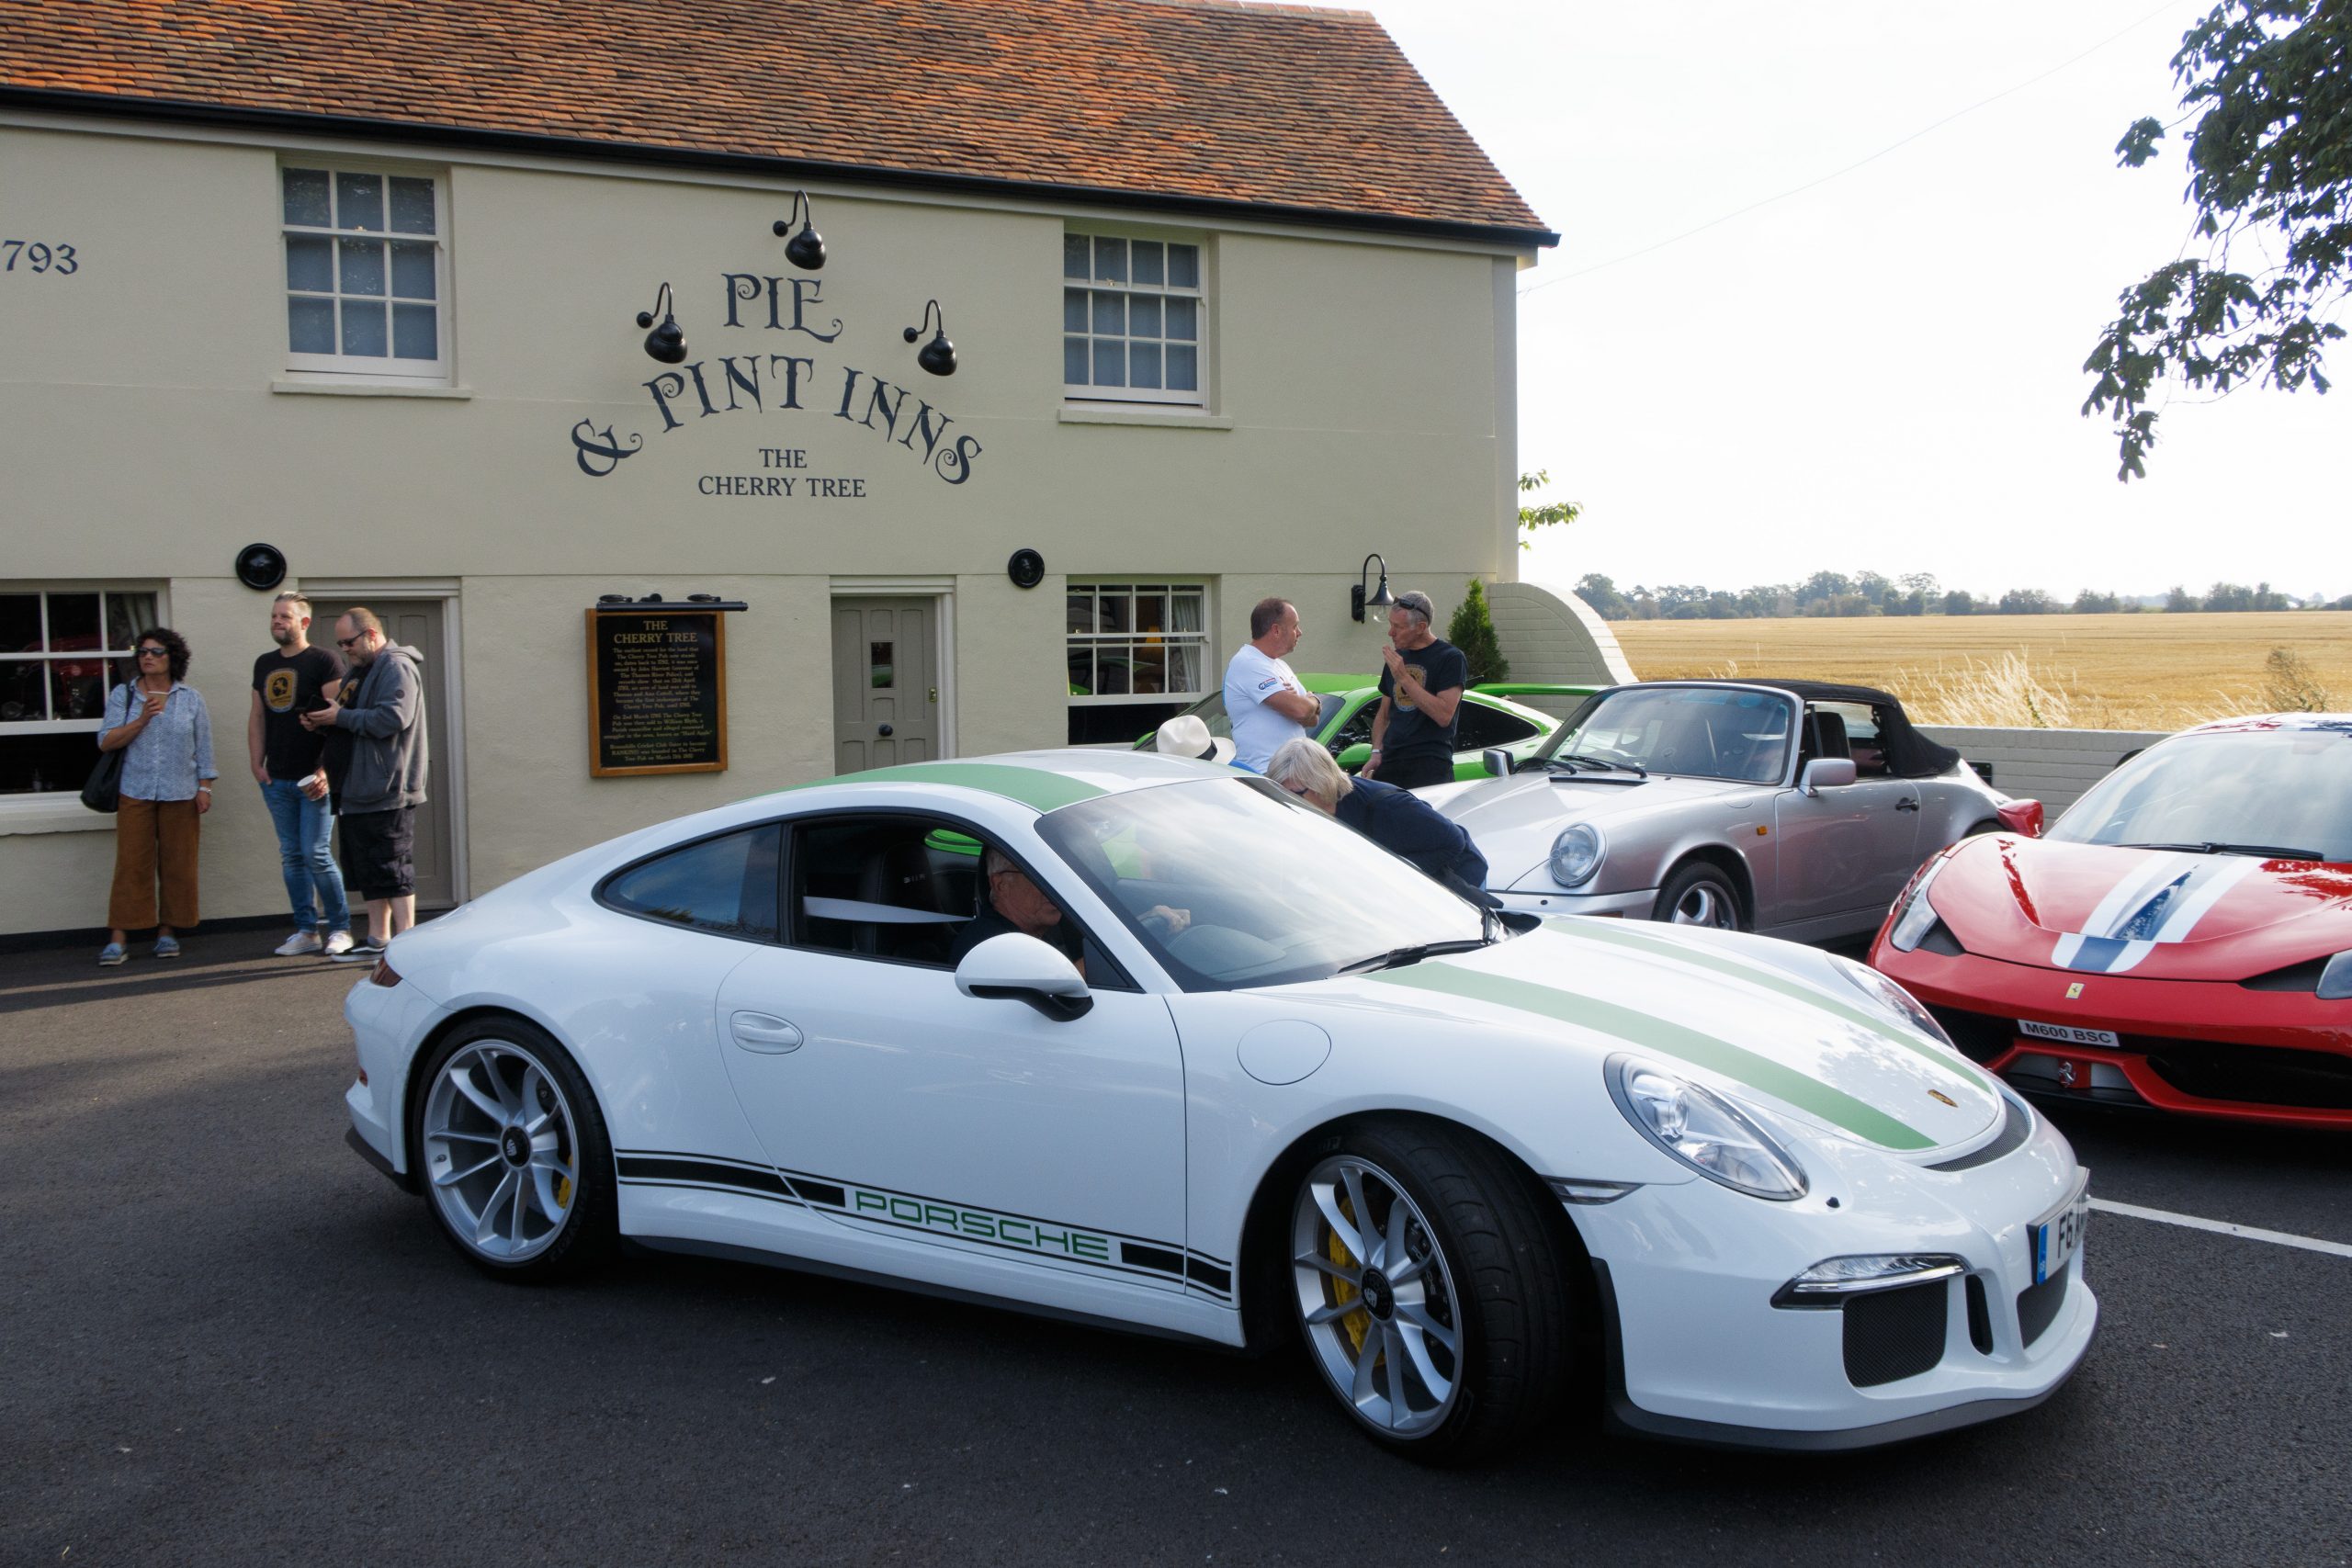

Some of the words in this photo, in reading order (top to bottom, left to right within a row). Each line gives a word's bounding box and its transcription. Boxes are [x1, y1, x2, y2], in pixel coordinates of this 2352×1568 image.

[721, 273, 843, 344] PIE
[571, 418, 643, 477] &
[642, 354, 814, 434] PINT
[833, 367, 983, 485] INNS
[758, 448, 808, 468] THE
[698, 476, 797, 497] CHERRY
[806, 478, 866, 498] TREE
[643, 620, 669, 631] THE
[614, 633, 662, 644] CHERRY
[666, 632, 698, 643] TREE
[2025, 1022, 2069, 1039] M600
[2073, 1029, 2112, 1043] BSC
[855, 1190, 1110, 1261] PORSCHE
